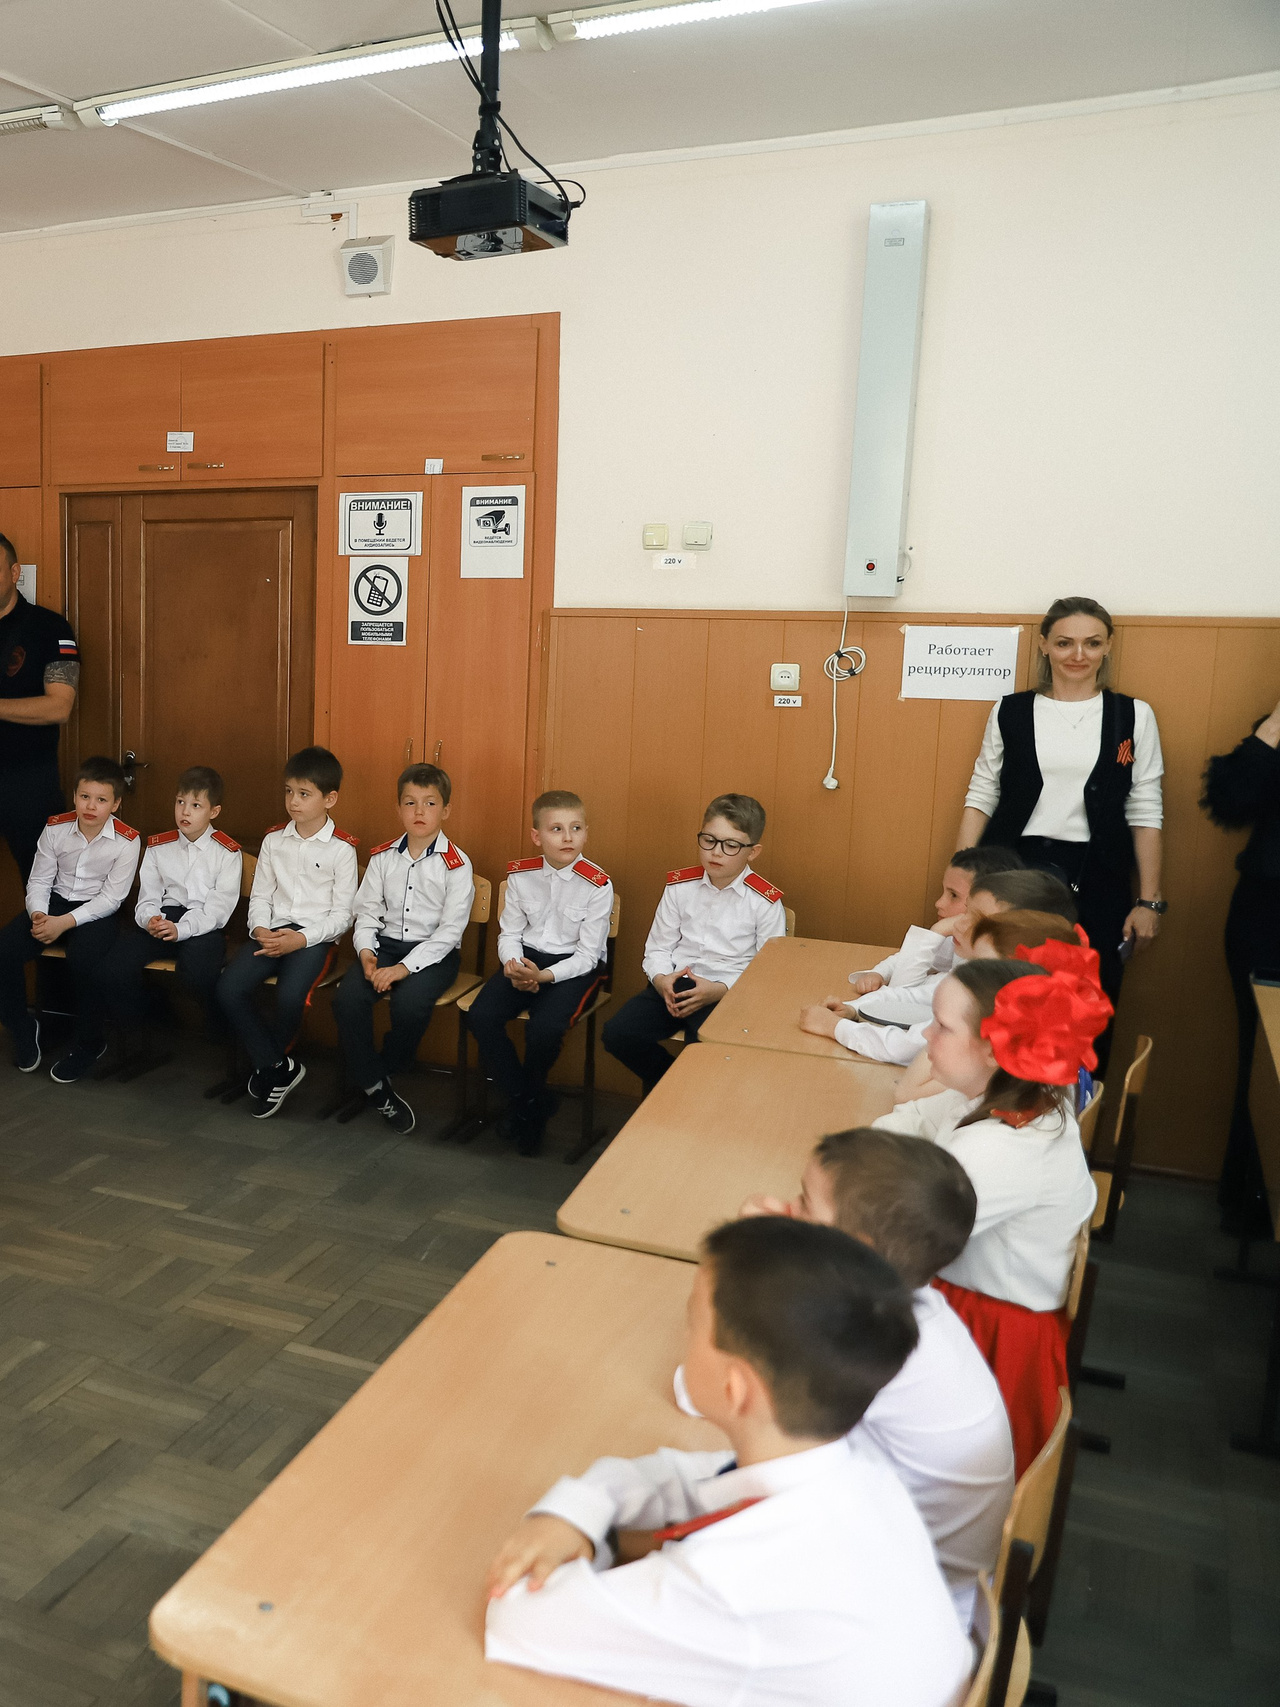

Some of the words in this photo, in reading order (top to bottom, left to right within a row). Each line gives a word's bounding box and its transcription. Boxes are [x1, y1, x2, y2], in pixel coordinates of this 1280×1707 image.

[351, 501, 410, 510] ВНИМАНИЕ!
[928, 644, 993, 656] Работает
[908, 665, 1011, 679] рециркулятор
[764, 887, 778, 897] КК
